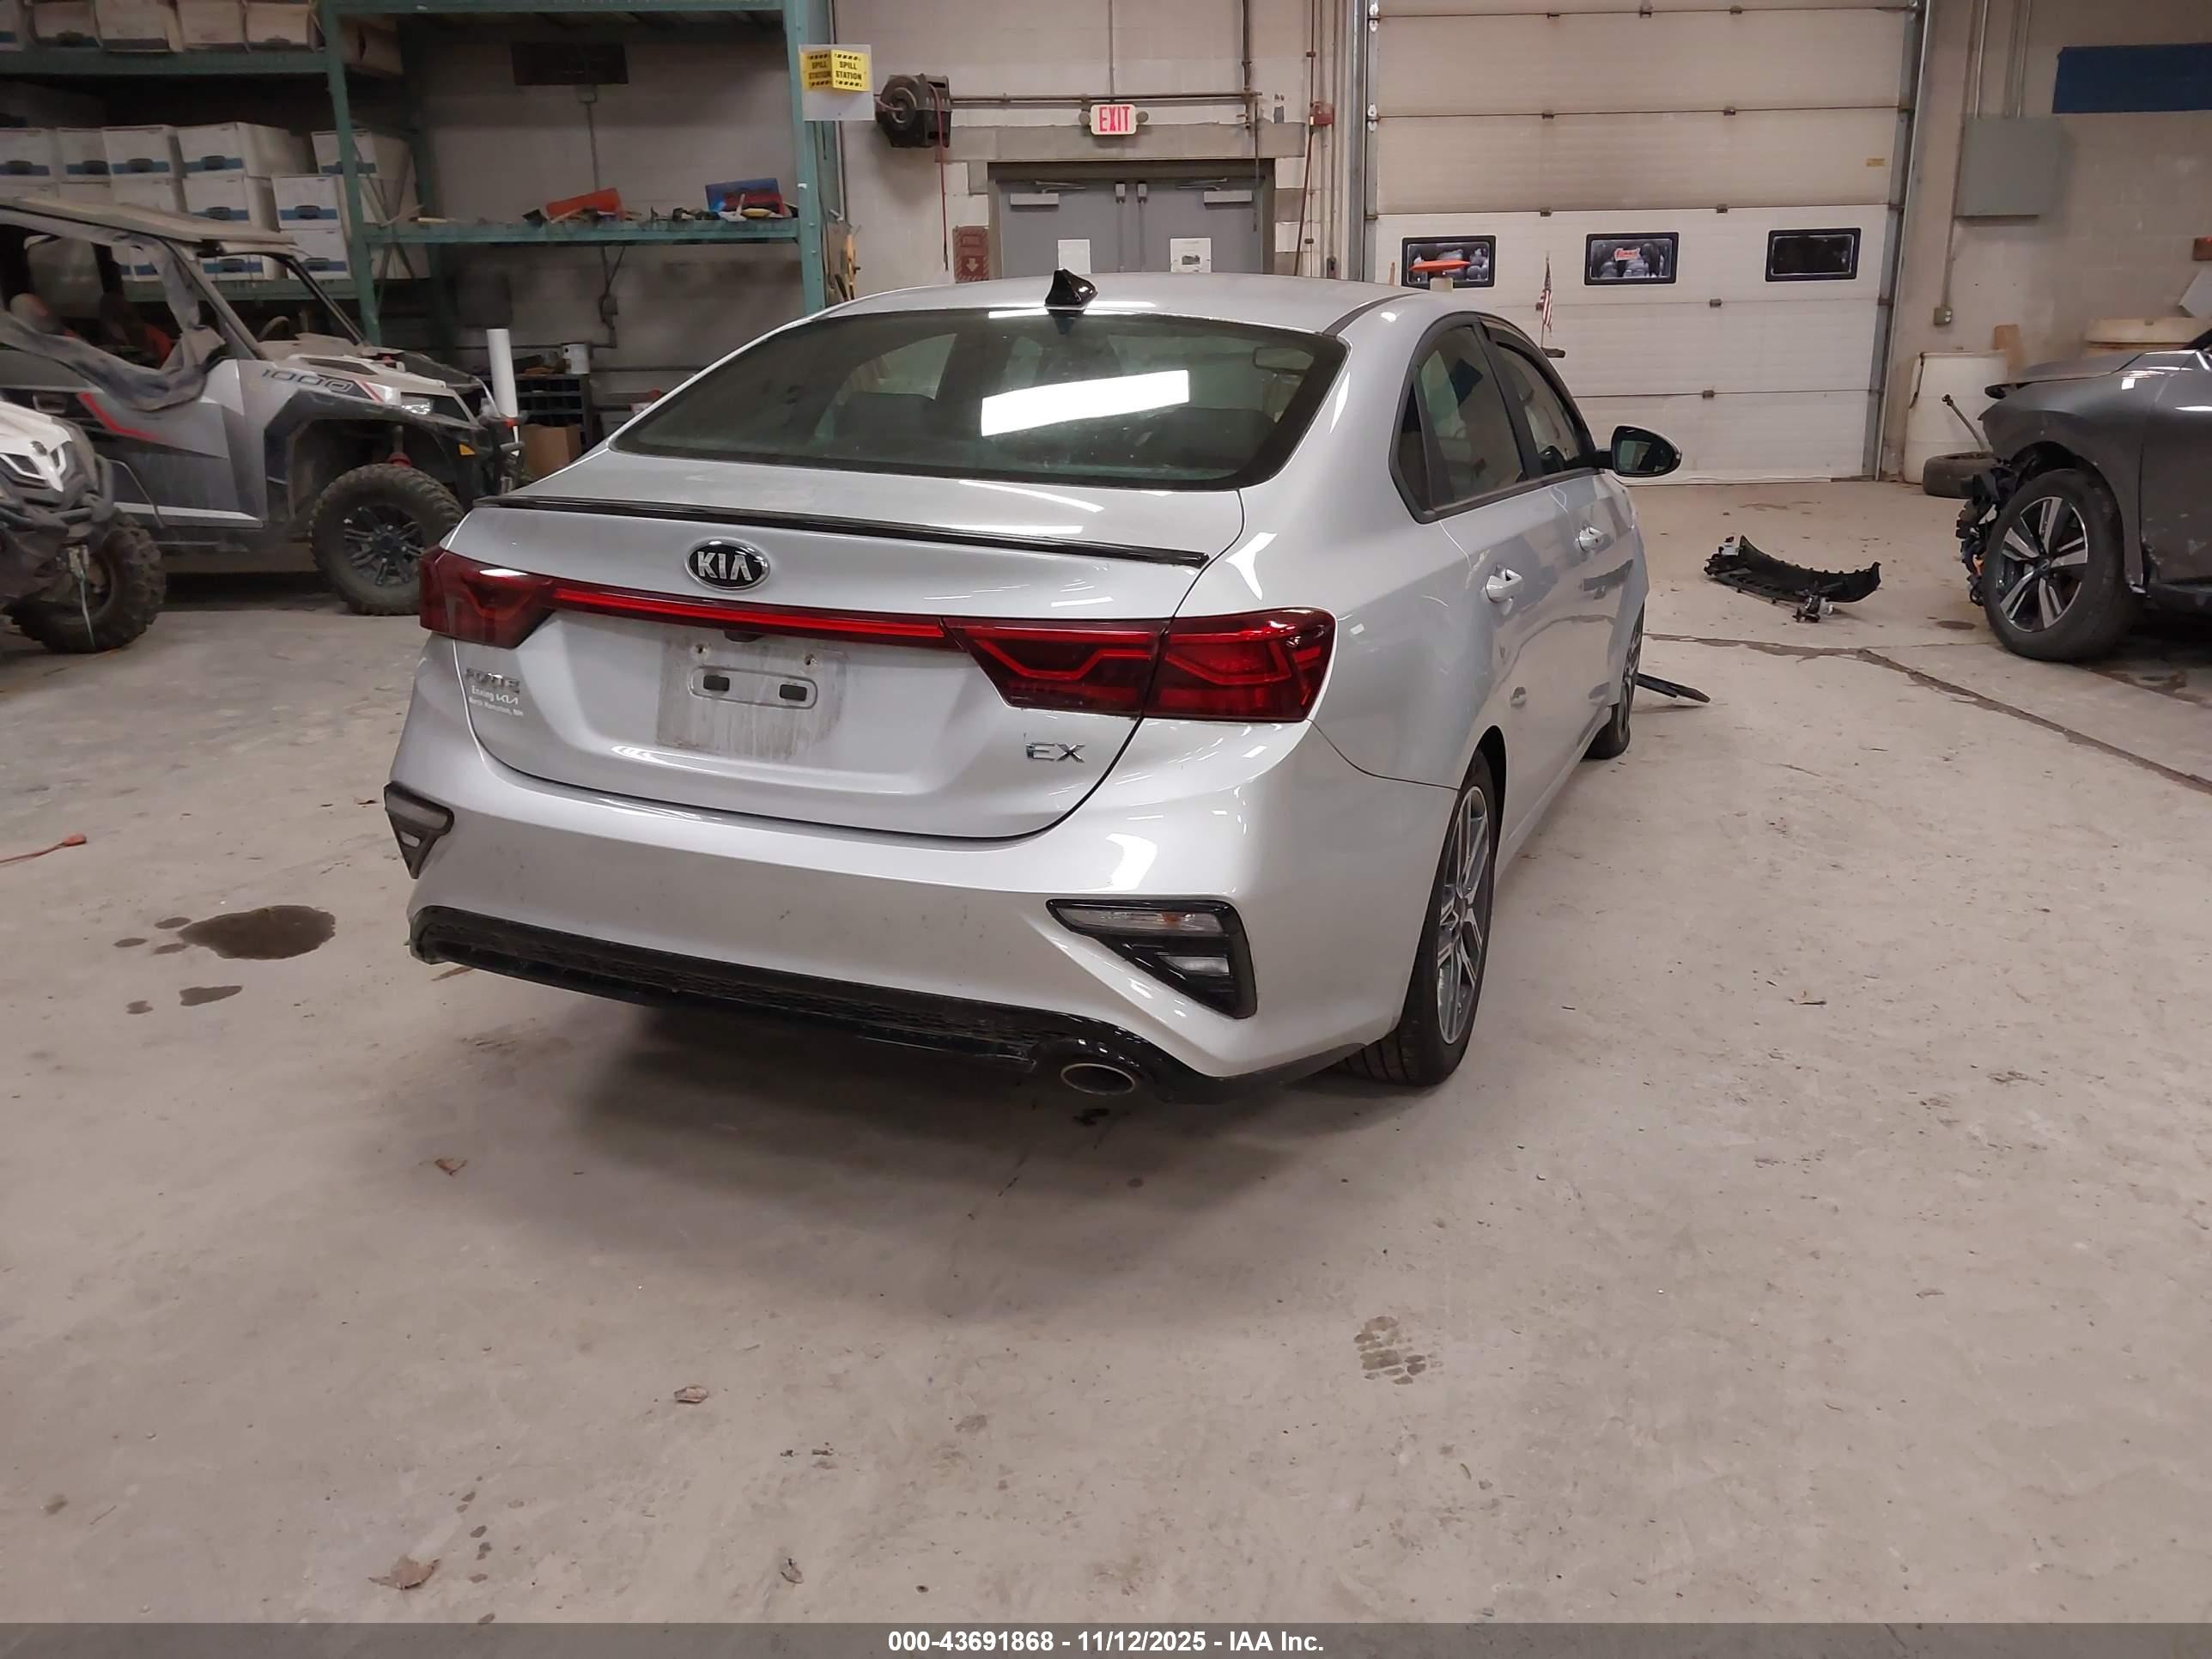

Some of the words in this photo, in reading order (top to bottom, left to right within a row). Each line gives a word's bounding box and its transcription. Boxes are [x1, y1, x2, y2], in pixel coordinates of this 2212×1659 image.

[836, 70, 862, 81] STATION
[839, 61, 857, 70] SPILL
[1099, 106, 1130, 131] EXIT
[261, 369, 355, 393] 1000
[696, 550, 753, 581] KIA
[1025, 742, 1086, 763] EX
